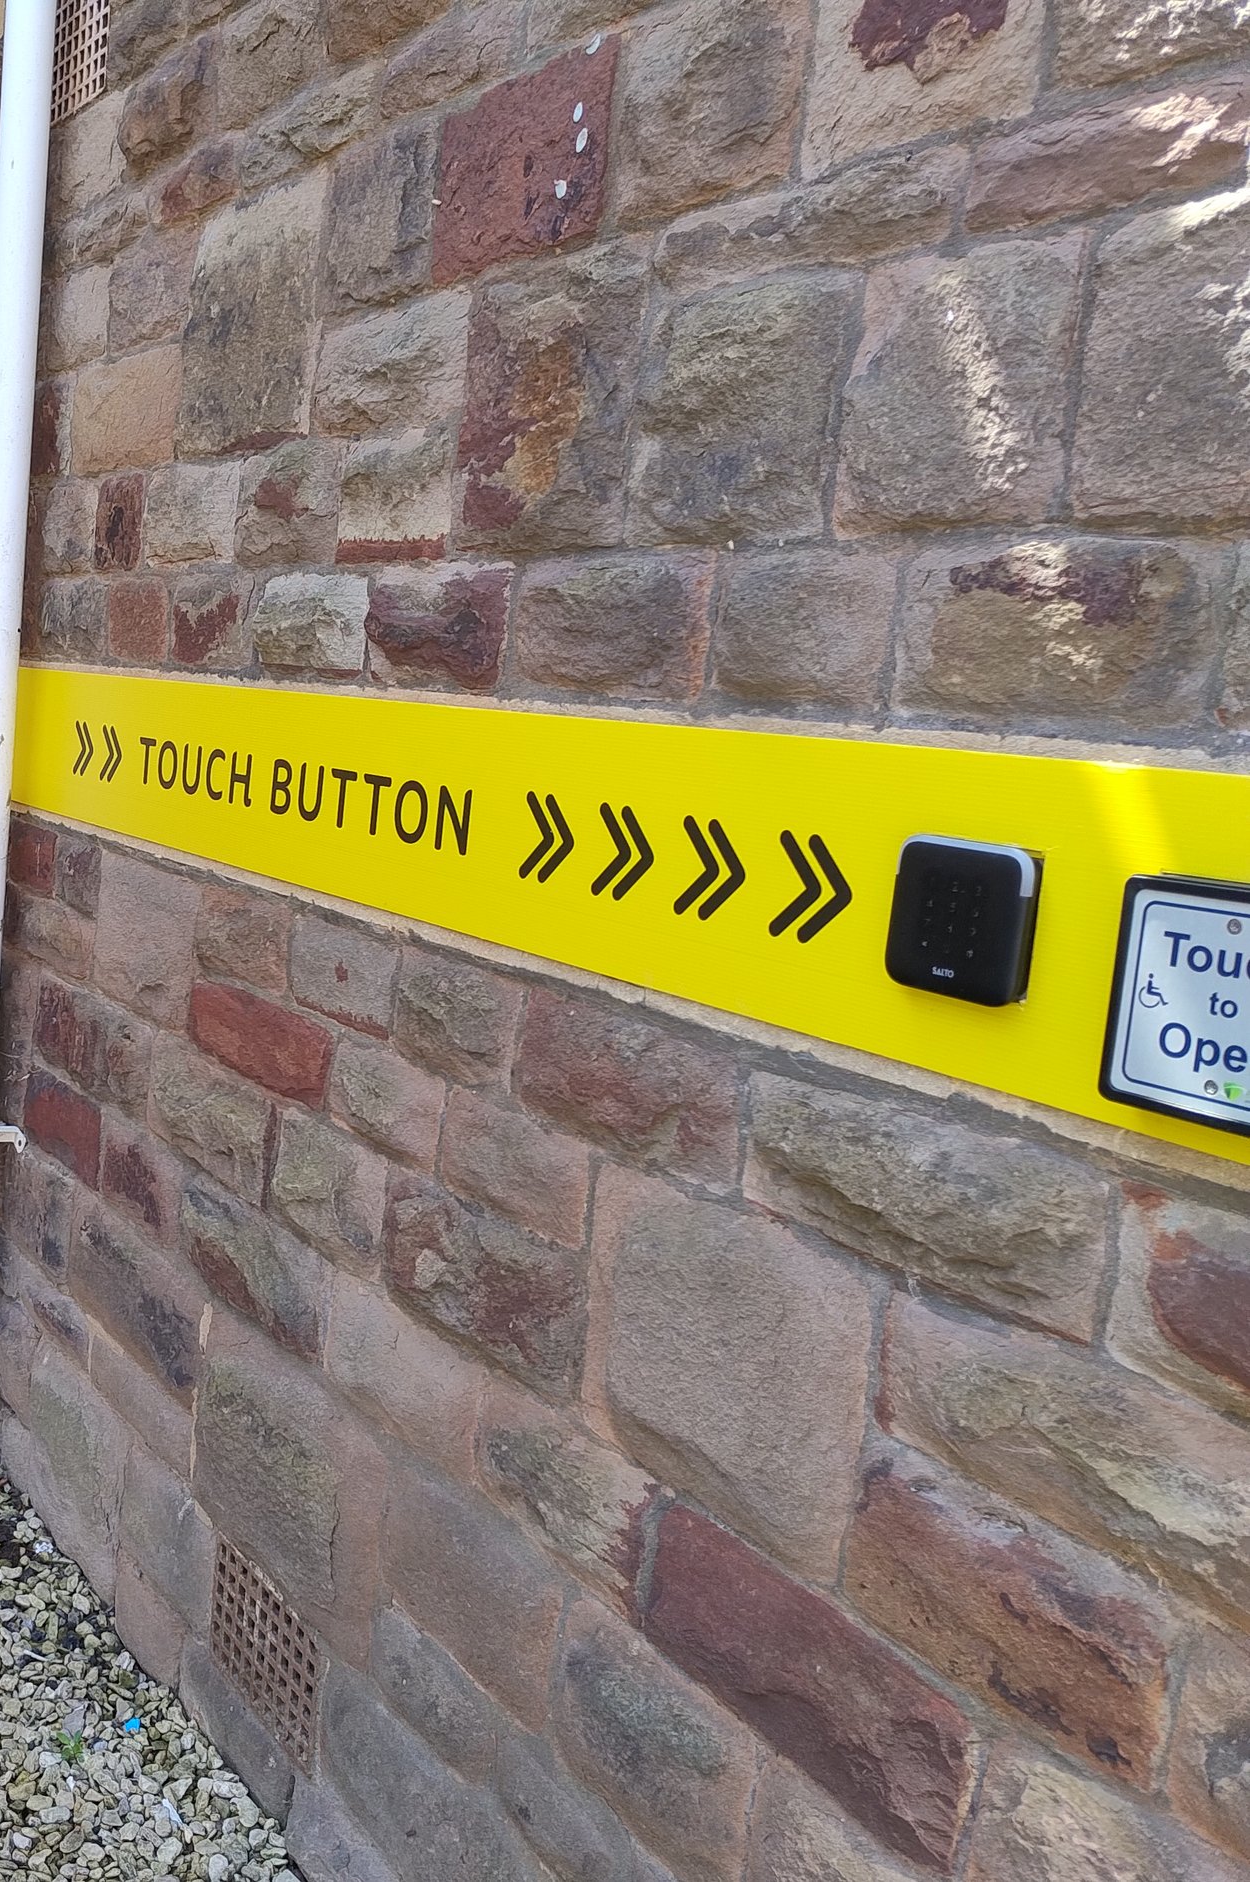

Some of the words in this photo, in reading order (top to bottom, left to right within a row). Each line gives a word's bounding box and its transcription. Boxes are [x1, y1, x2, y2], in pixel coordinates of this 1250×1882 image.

[139, 735, 253, 808] TOUCH
[269, 756, 473, 856] BUTTON
[1164, 931, 1250, 979] Tou
[1209, 992, 1238, 1018] to
[1159, 1022, 1248, 1073] Ope
